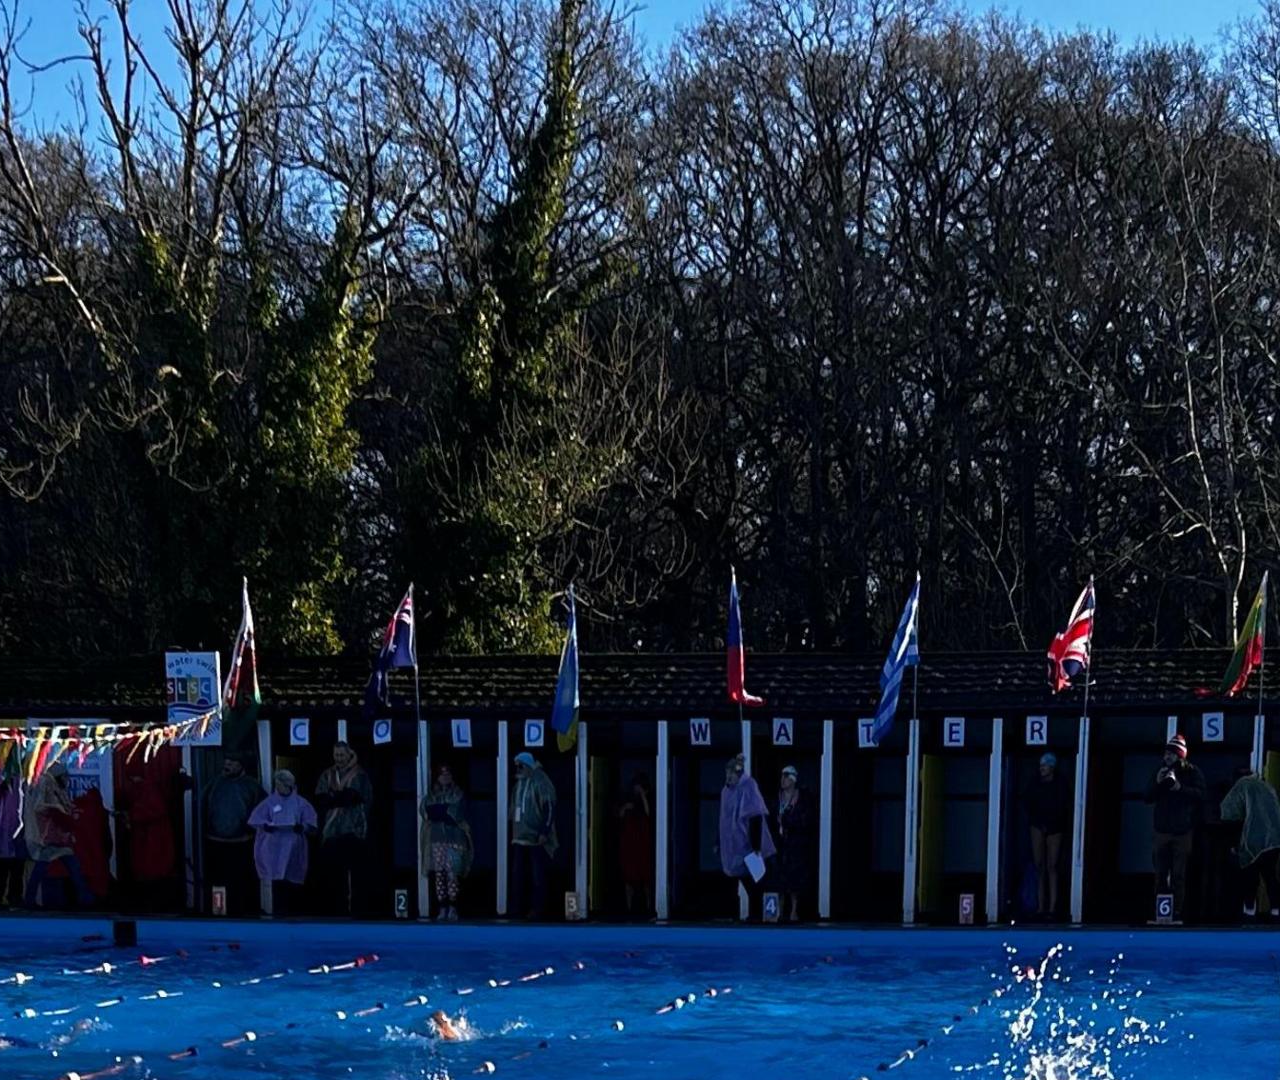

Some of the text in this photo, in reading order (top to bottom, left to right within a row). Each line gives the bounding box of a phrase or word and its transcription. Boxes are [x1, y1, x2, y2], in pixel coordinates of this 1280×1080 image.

[166, 680, 211, 695] SLSC
[293, 721, 542, 743] COLD
[689, 719, 1045, 744] WATER
